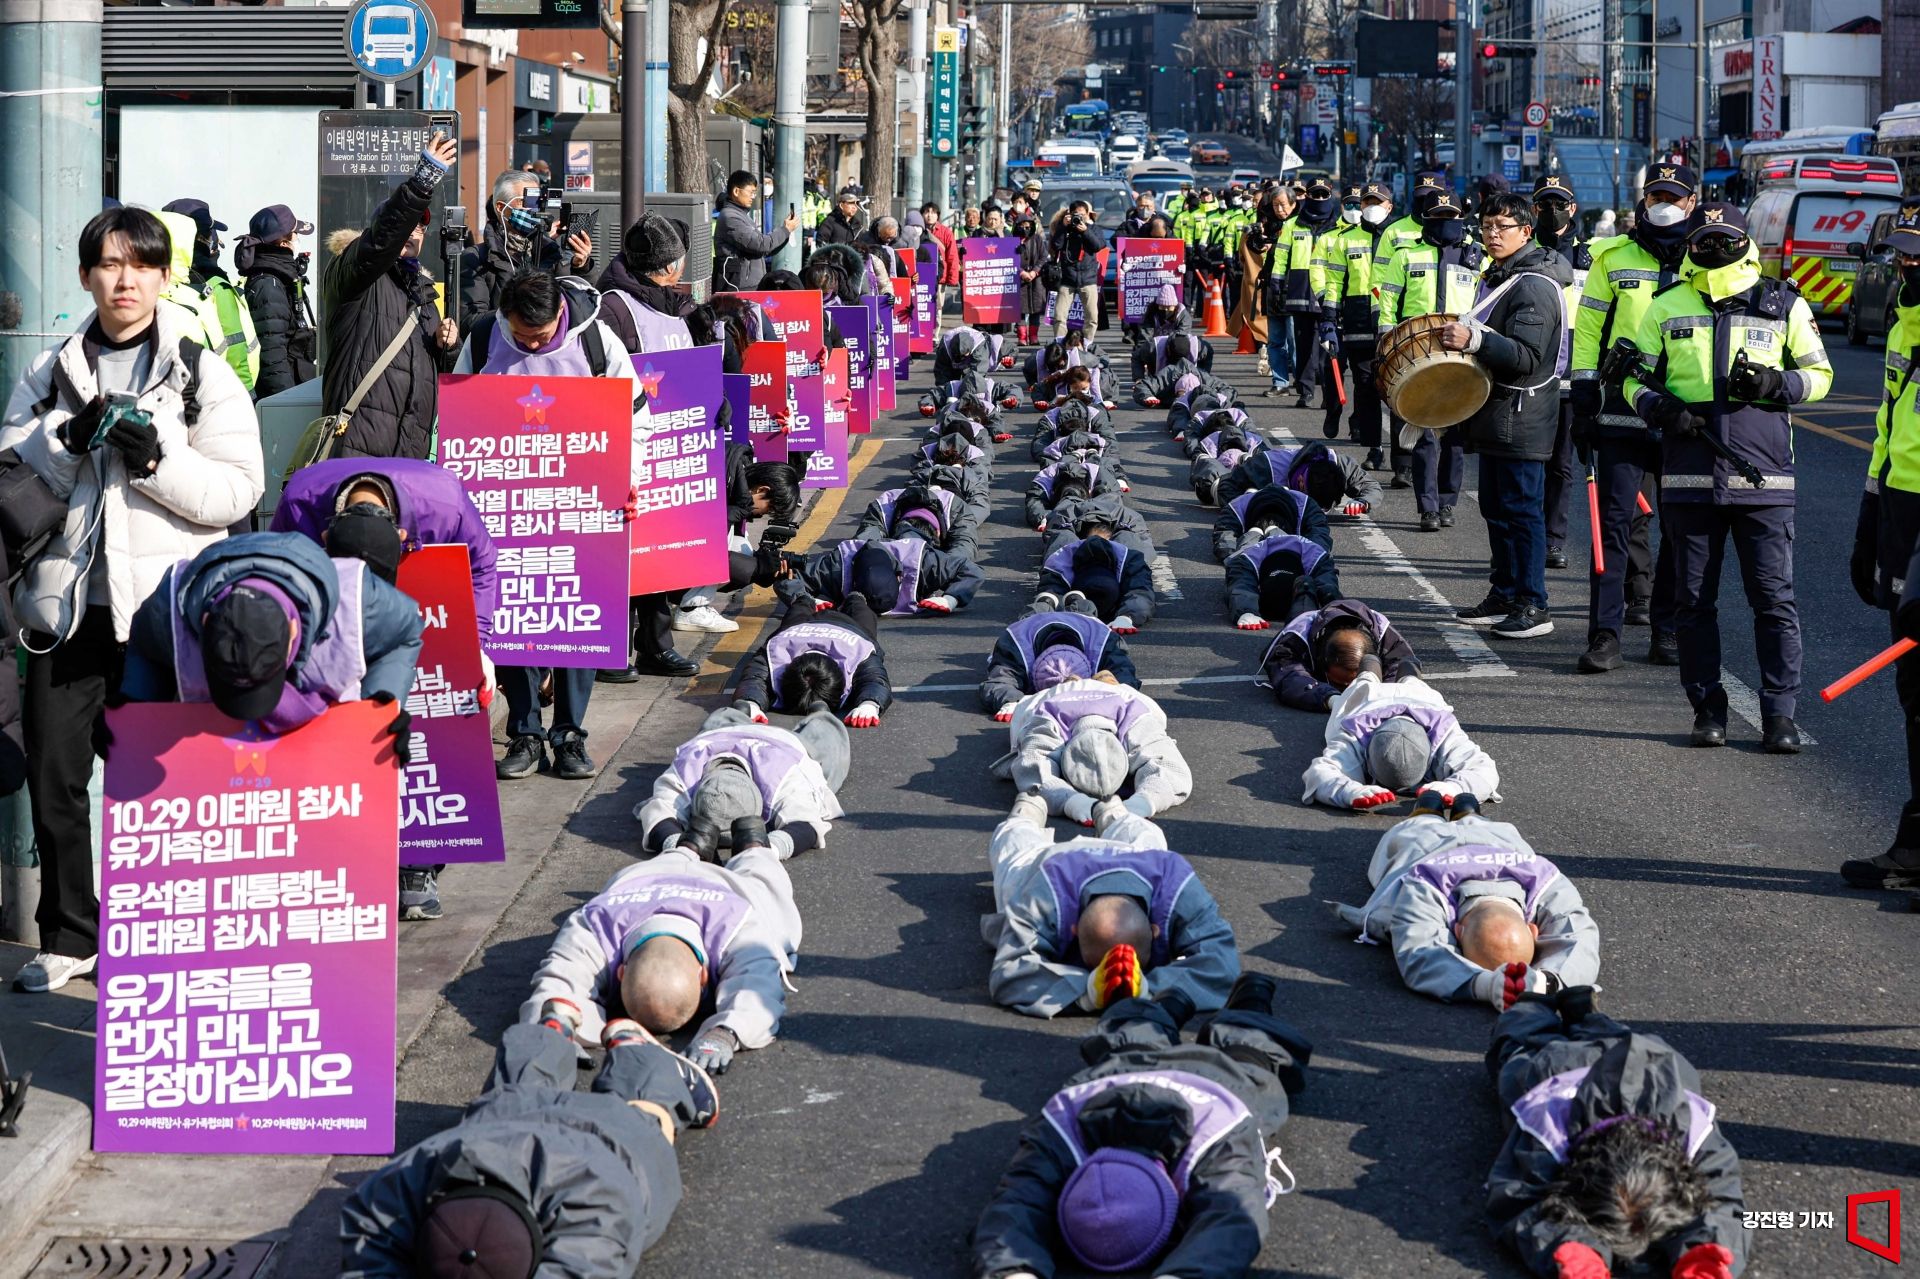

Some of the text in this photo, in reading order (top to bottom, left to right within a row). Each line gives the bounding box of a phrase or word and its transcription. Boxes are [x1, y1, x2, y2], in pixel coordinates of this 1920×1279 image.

[554, 2, 582, 14] Topis
[943, 53, 949, 64] 1
[941, 73, 950, 113] 이태원
[1760, 40, 1775, 129] TRANS
[1529, 109, 1543, 121] 50
[330, 153, 354, 161] Itaewon
[357, 153, 378, 161] Station
[381, 153, 392, 161] Exit
[350, 163, 377, 174] 정류소
[381, 164, 390, 172] ID
[1812, 210, 1866, 233] 119
[787, 320, 810, 334] 참사
[1748, 340, 1770, 349] POLICE
[442, 431, 608, 460] 10.29 이태원 참사
[681, 430, 717, 455] 참사
[655, 454, 707, 480] 특별법
[511, 486, 603, 511] 대통령님,
[511, 513, 555, 537] 참사
[559, 509, 625, 534] 특별법
[496, 545, 576, 575] 족들을
[501, 575, 582, 606] 만나고
[418, 605, 448, 630] 사
[492, 603, 602, 635] 하십시오
[109, 783, 362, 834] 10.29 이태원 참사
[109, 824, 298, 871] 유가족입니다
[107, 868, 354, 919] 윤석열 대통령님,
[107, 904, 387, 958] 이태원 참사 특별법
[105, 963, 313, 1020] 유가족들을
[105, 1009, 321, 1065] 먼저 만나고
[104, 1053, 353, 1112] 결정하십시오
